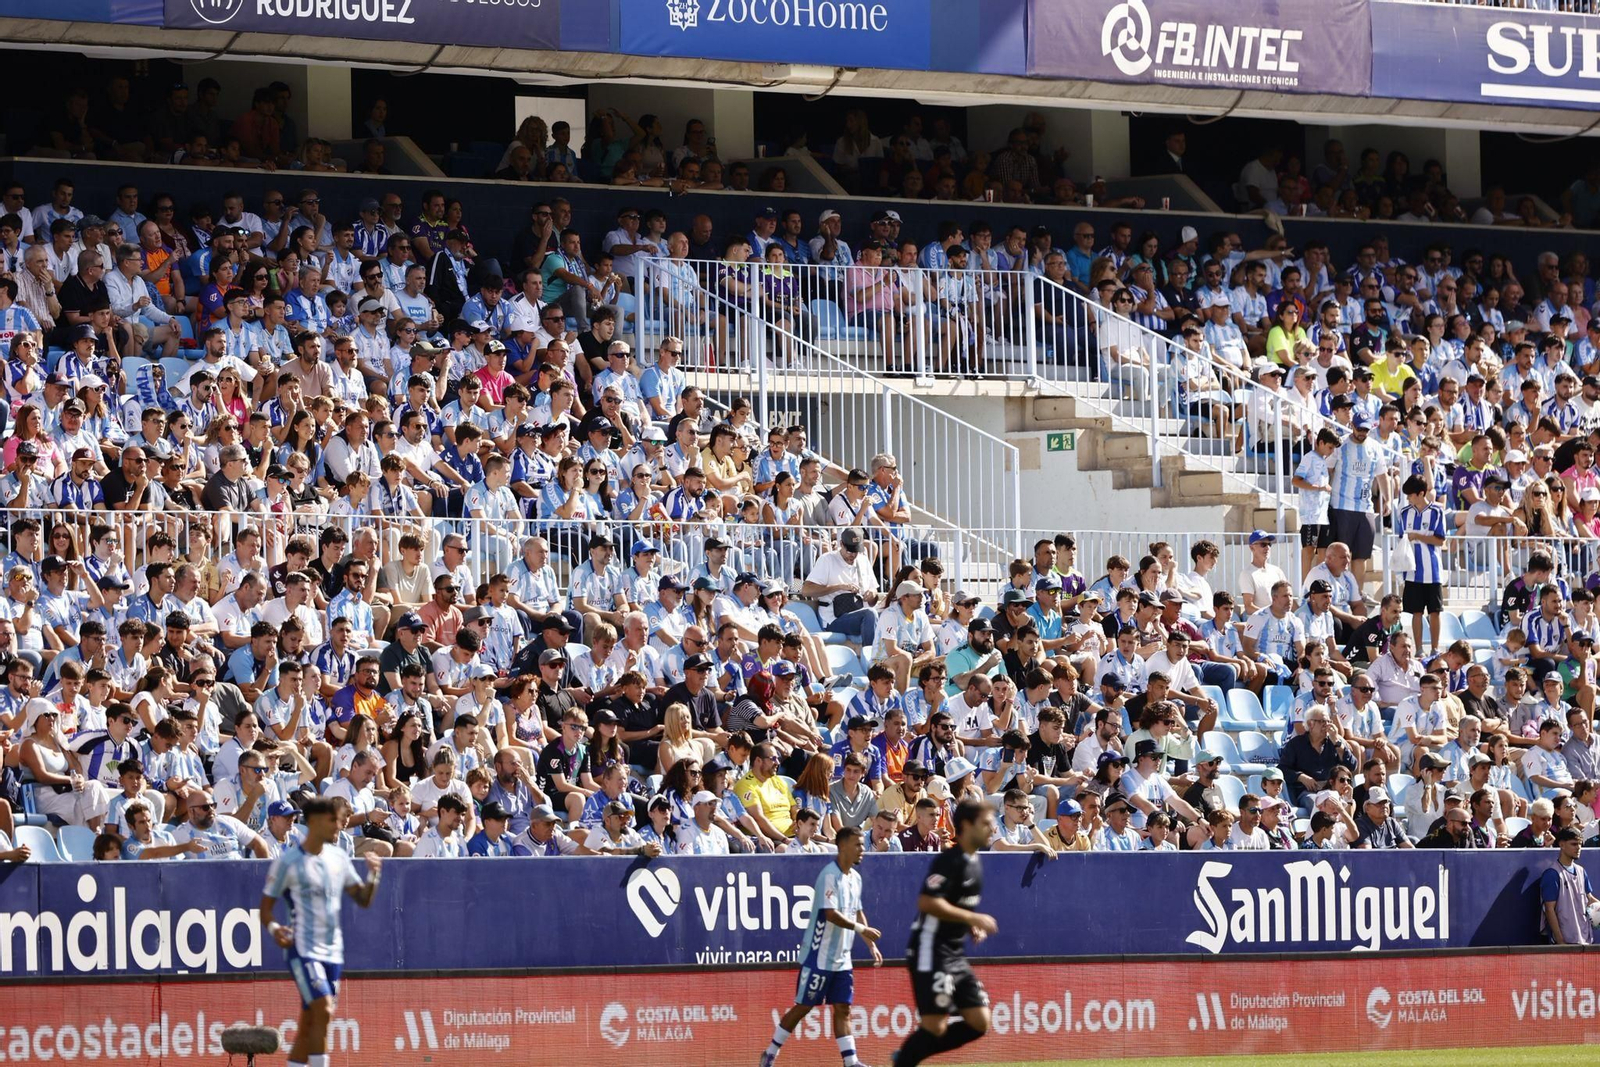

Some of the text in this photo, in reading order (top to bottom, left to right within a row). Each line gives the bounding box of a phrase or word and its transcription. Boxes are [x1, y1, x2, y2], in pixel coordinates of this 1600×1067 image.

[1154, 69, 1299, 86] INGENIERÍA E INSTALACIONES TÉCNICAS
[768, 410, 802, 429] EXIT
[695, 946, 731, 964] vivir
[809, 973, 827, 991] 31
[1230, 990, 1345, 1011] Diputación Provincial
[1397, 988, 1486, 1005] COSTA DEL SOL
[1511, 979, 1600, 1020] visita
[443, 1006, 576, 1029] Diputación Provincial
[636, 1004, 738, 1023] COSTA DEL SOL
[1231, 1012, 1288, 1034] de Málaga
[1398, 1006, 1448, 1022] MÁLAGA
[444, 1032, 510, 1052] de Málaga
[637, 1024, 694, 1041] MÁLAGA
